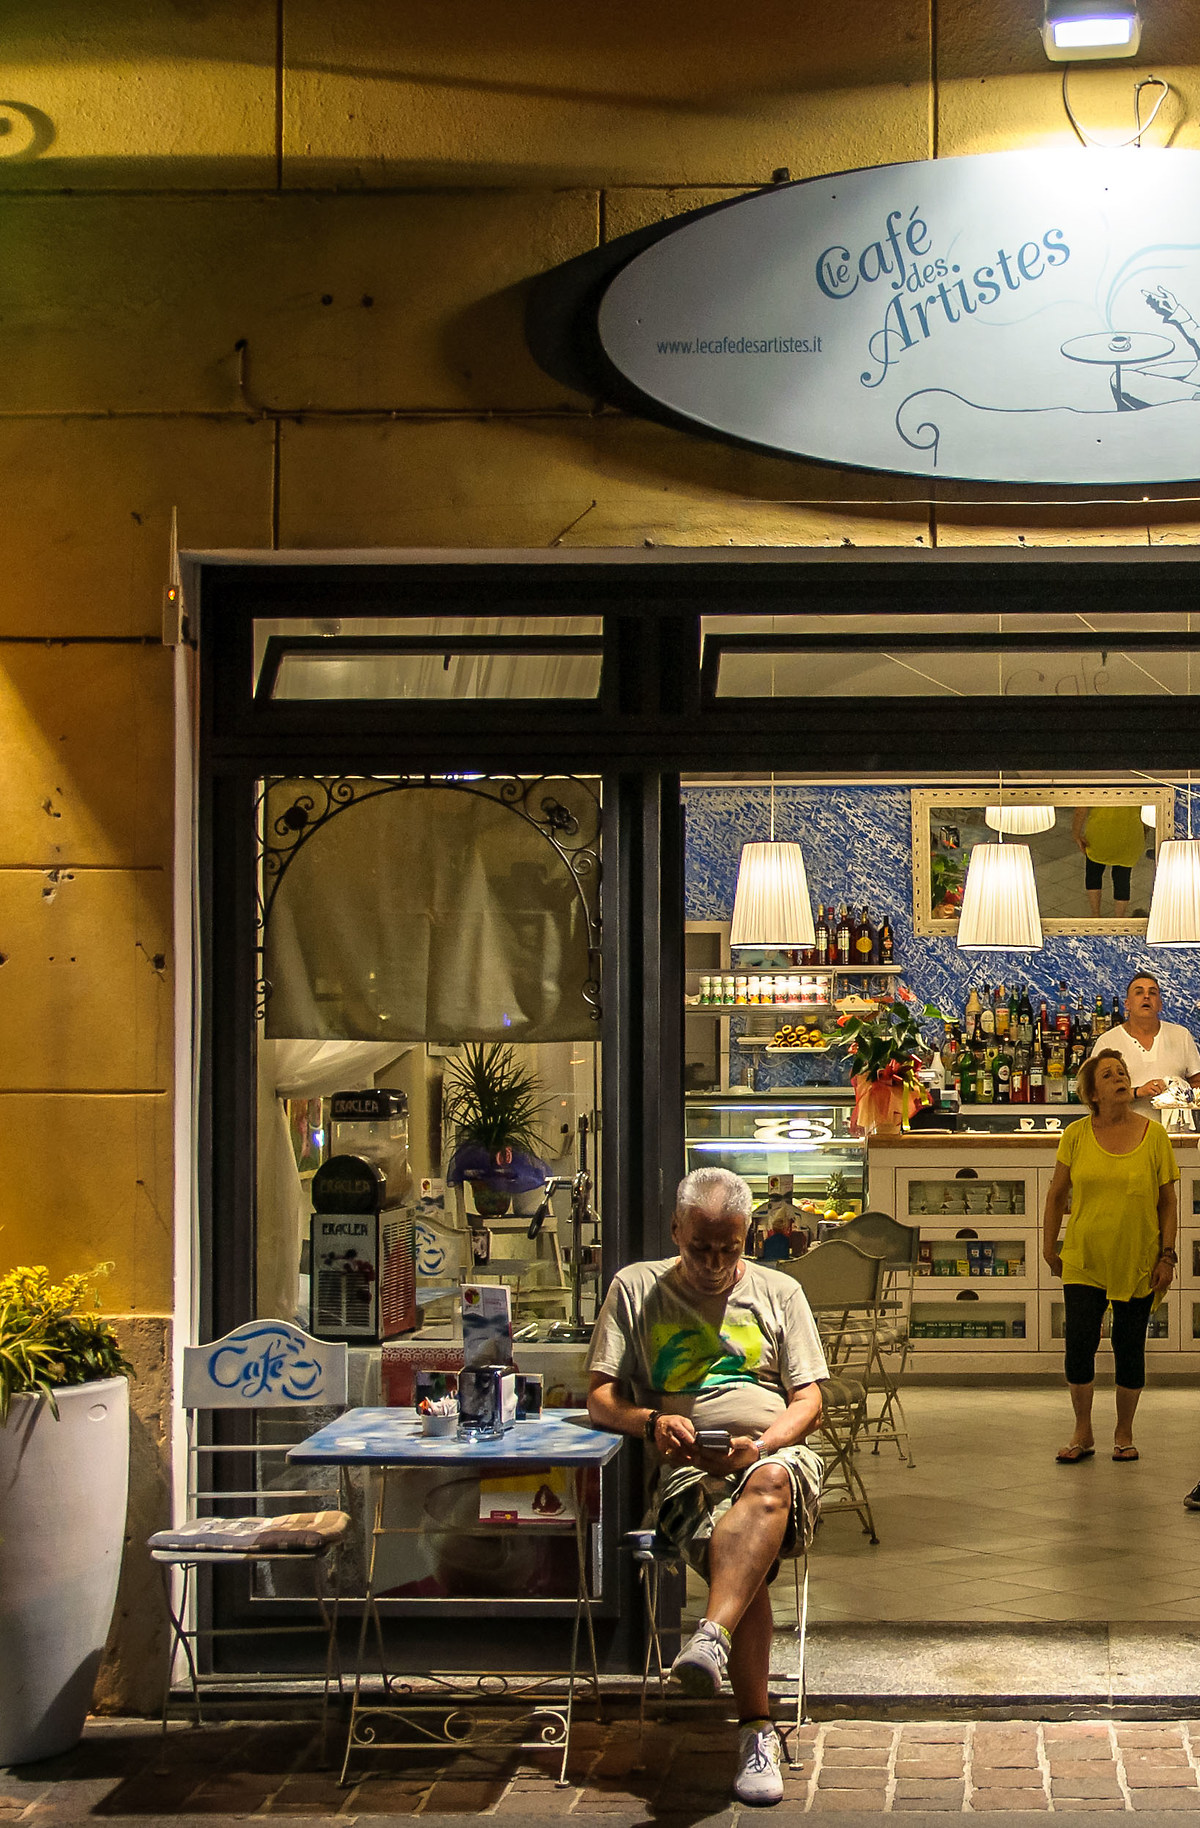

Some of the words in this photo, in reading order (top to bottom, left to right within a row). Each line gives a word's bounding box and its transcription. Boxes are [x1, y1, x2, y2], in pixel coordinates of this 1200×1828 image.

[815, 206, 933, 299] Café
[905, 256, 950, 293] des
[860, 228, 1071, 388] Artistes
[656, 334, 823, 354] www.lecafedesartistes.it
[334, 1099, 379, 1113] ERACLEA
[322, 1222, 368, 1236] ERACLEA
[208, 1340, 286, 1398] Café
